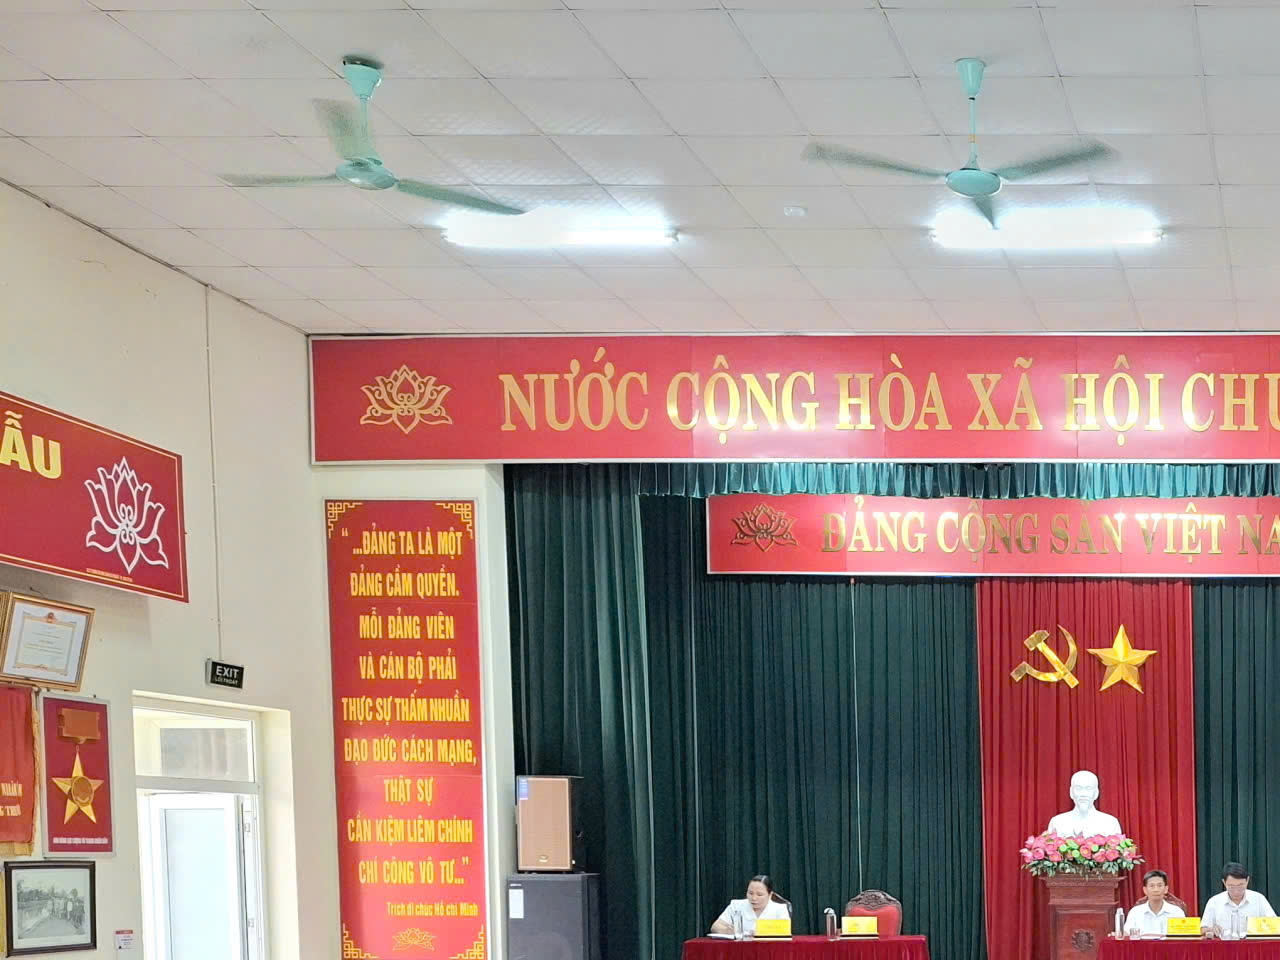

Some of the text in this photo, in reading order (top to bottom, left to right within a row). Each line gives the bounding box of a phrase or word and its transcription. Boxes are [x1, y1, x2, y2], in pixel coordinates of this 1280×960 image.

[499, 347, 649, 431] NƯỚC
[666, 355, 819, 444] CỘNG
[834, 353, 952, 431] HÒA
[967, 357, 1043, 430] XÃ
[1062, 354, 1164, 446] HỘI
[399, 531, 413, 555] TA
[418, 526, 433, 555] LÀ
[438, 526, 463, 560] MỘT
[821, 495, 928, 552] ĐẢNG
[936, 501, 1040, 561] CỘNG
[1134, 502, 1226, 563] VIỆT
[350, 564, 460, 599] ĐẢNG CẦM QUYỀN.
[359, 607, 454, 639] MỖI ĐẢNG VIÊN
[216, 665, 239, 679] EXIT
[359, 648, 457, 684] VÀ CÁN BỘ PHẢI
[342, 689, 470, 725] THỰC SỰ THẤM NHUẦN
[344, 734, 477, 766] ĐẠO ĐỨC CÁCH MẠNG,
[384, 774, 434, 806] THẬT SỰ
[376, 815, 404, 846] KIỆM
[407, 815, 435, 843] LIÊM
[438, 815, 473, 843] CHÍNH
[359, 856, 378, 884] CHÍ
[383, 856, 414, 884] CÔNG
[419, 857, 434, 884] VÔ
